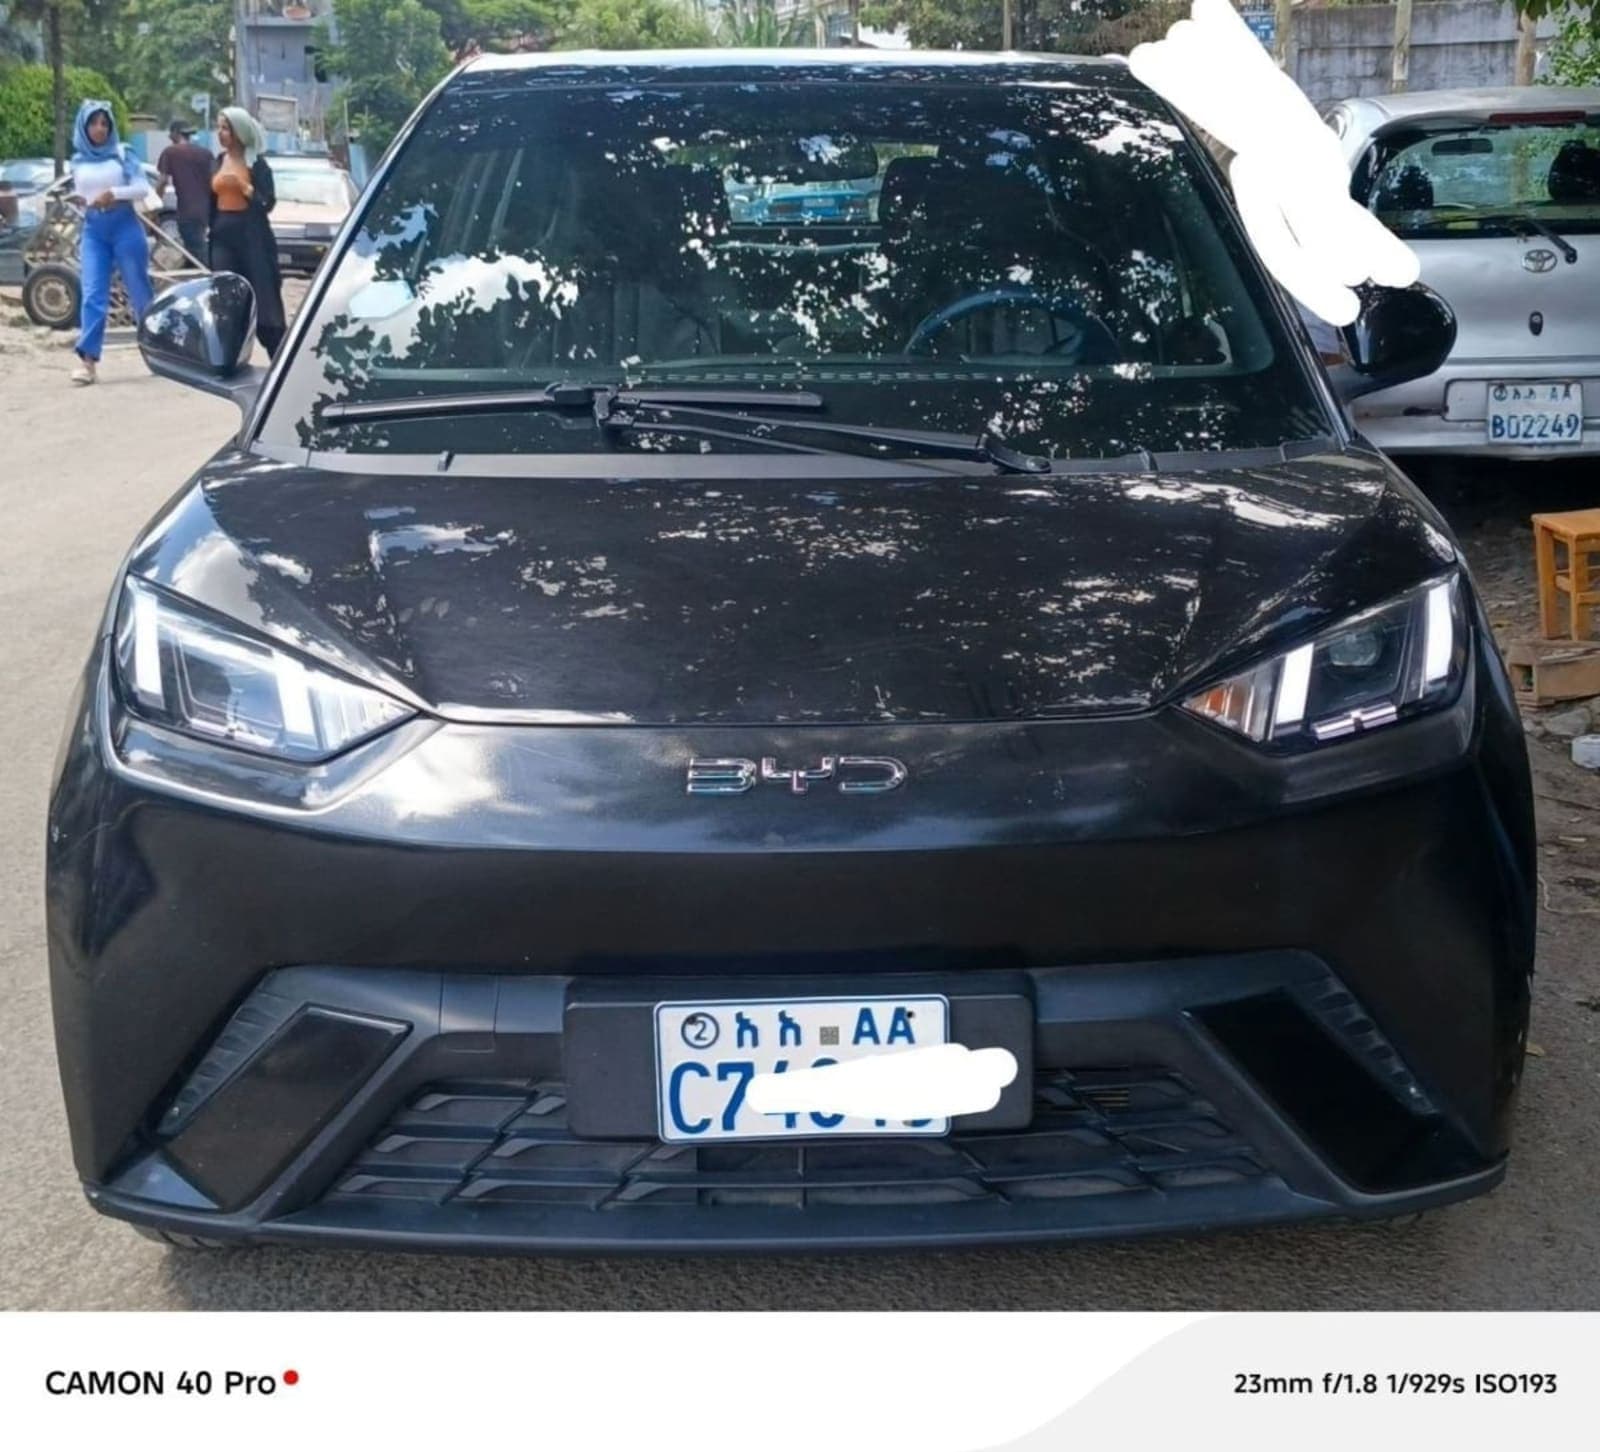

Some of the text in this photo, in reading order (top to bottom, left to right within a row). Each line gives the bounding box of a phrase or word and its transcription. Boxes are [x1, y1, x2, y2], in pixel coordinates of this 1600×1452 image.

[1491, 413, 1579, 439] B02249
[687, 756, 907, 794] BYD
[852, 1006, 915, 1046] AA
